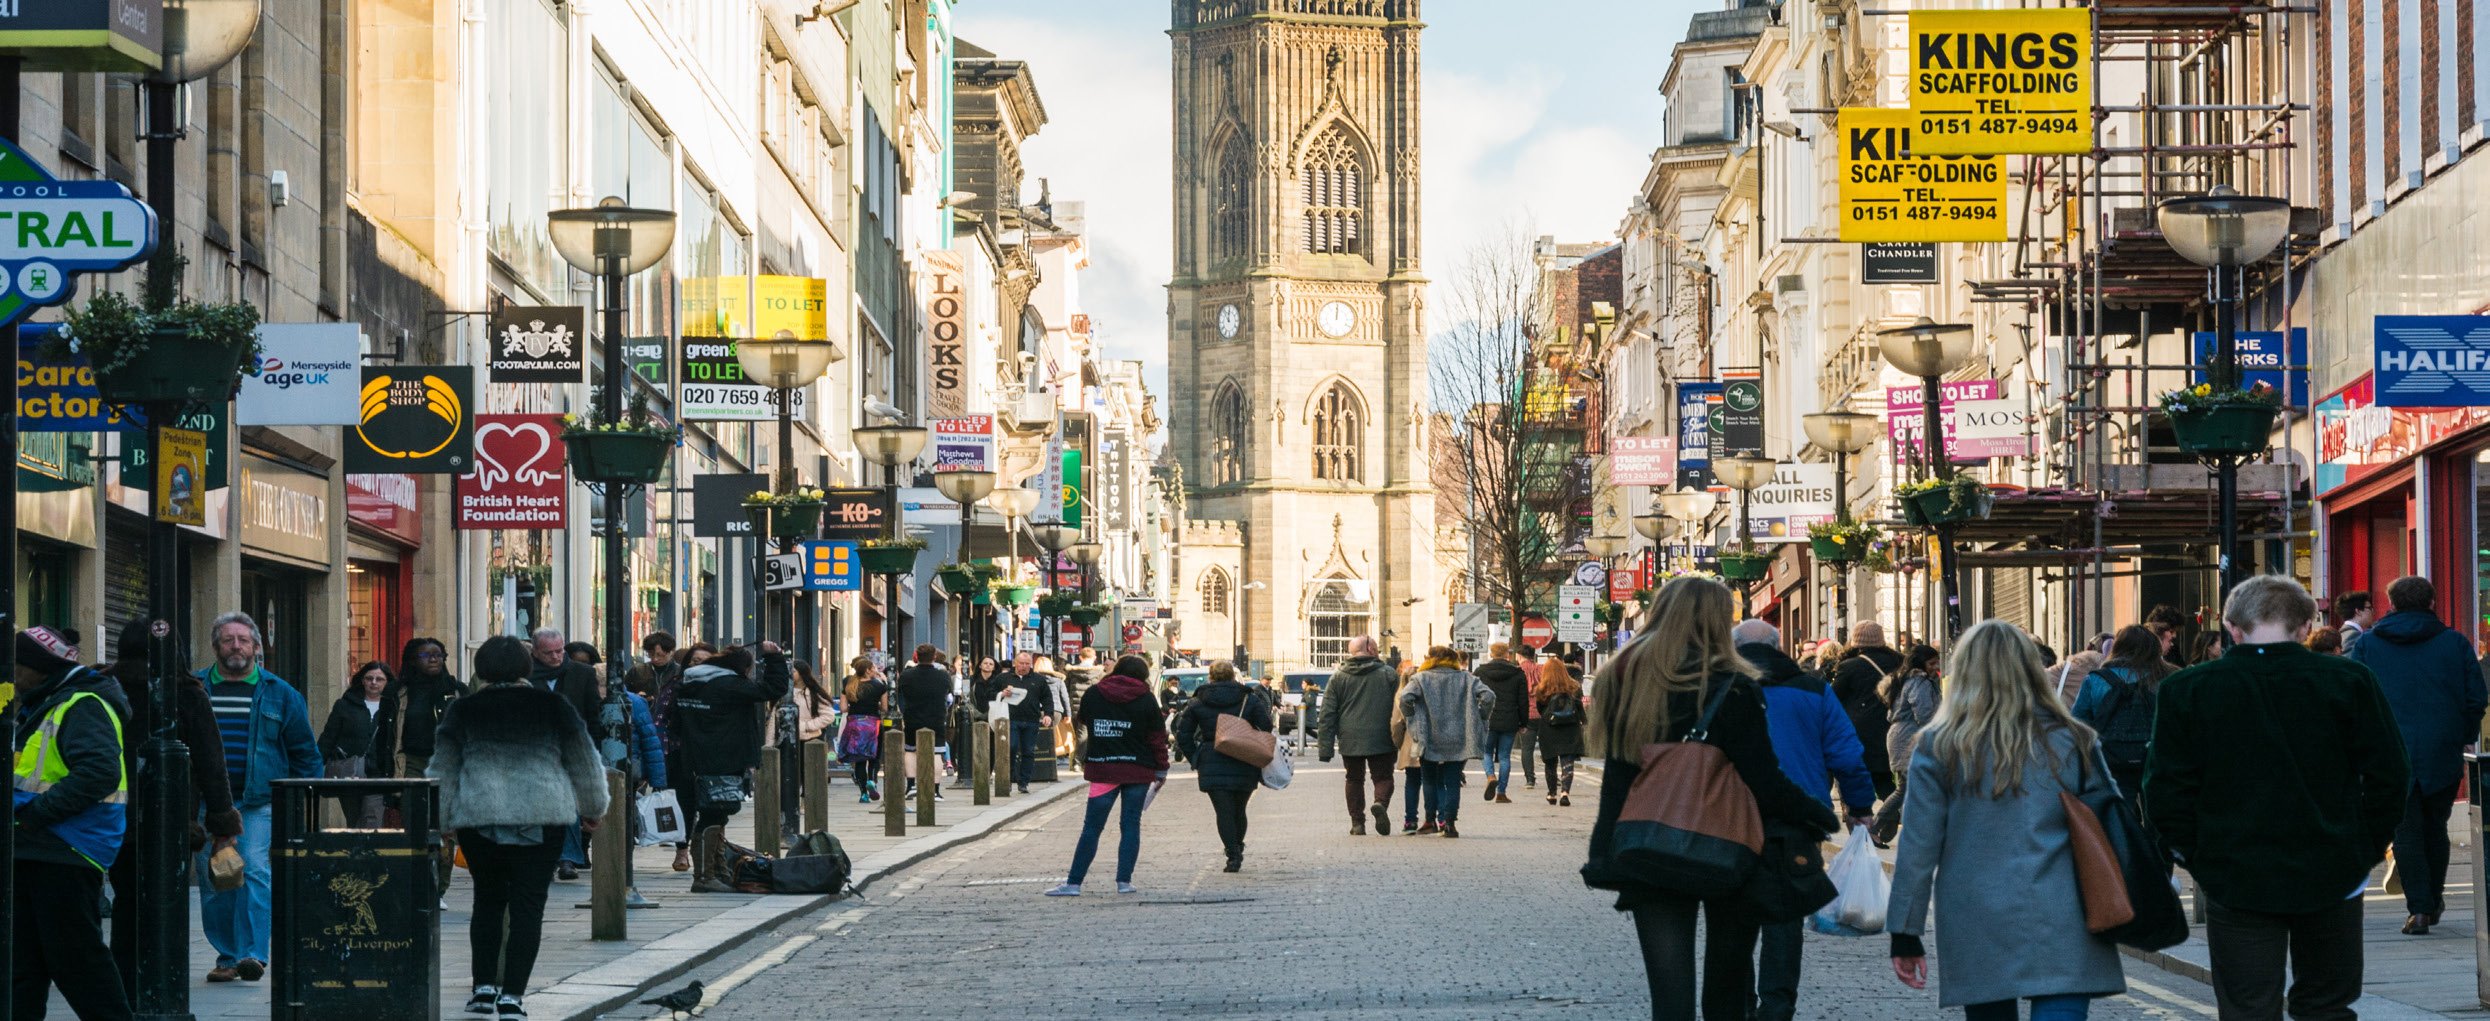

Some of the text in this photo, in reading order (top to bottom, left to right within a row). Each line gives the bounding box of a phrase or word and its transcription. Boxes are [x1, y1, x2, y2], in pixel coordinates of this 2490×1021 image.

[118, 0, 147, 34] Central
[1919, 33, 2078, 69] KINGS
[1919, 73, 2078, 93] SCAFFOLDING
[1976, 99, 2022, 114] TEL.
[1921, 118, 2078, 134] 0151 487-9494
[0, 186, 67, 197] OOL
[1903, 189, 1946, 202] TEL.
[1852, 206, 1997, 220] 0151 487-9494
[1868, 249, 1933, 258] CHANDLER
[765, 297, 787, 310] TO
[793, 298, 824, 311] LET
[932, 274, 962, 389] LOOKS
[2235, 339, 2261, 351] HE
[2235, 353, 2278, 365] RKS
[2381, 350, 2490, 371] HALIF
[291, 361, 352, 371] Merseyside
[688, 362, 744, 380] TO LET
[264, 373, 329, 389] age UK
[394, 381, 421, 389] THE
[390, 389, 425, 397] BODY
[684, 388, 803, 406] 020 7659 488
[1892, 390, 1924, 405] SHO
[1960, 385, 1989, 400] LET
[390, 397, 426, 405] SHOP
[1893, 413, 1955, 429] maon
[1966, 411, 2024, 427] MOS
[939, 422, 982, 432] TO LET
[164, 432, 202, 446] Pedestrian
[1615, 439, 1670, 449] TO LET
[1980, 439, 2002, 447] Moss
[1991, 446, 2015, 454] HIRE
[947, 457, 983, 465] Goodman
[1615, 455, 1661, 463] mason
[1109, 439, 1119, 507] TATTOO
[1769, 471, 1803, 484] ALL
[463, 495, 560, 507] British Heart
[1748, 488, 1833, 504] NQUIRIES
[463, 509, 560, 522] Foundation
[842, 503, 868, 522] KO
[726, 521, 752, 532] RIC
[1672, 546, 1707, 556] UTIITY
[814, 578, 848, 586] GREGGS
